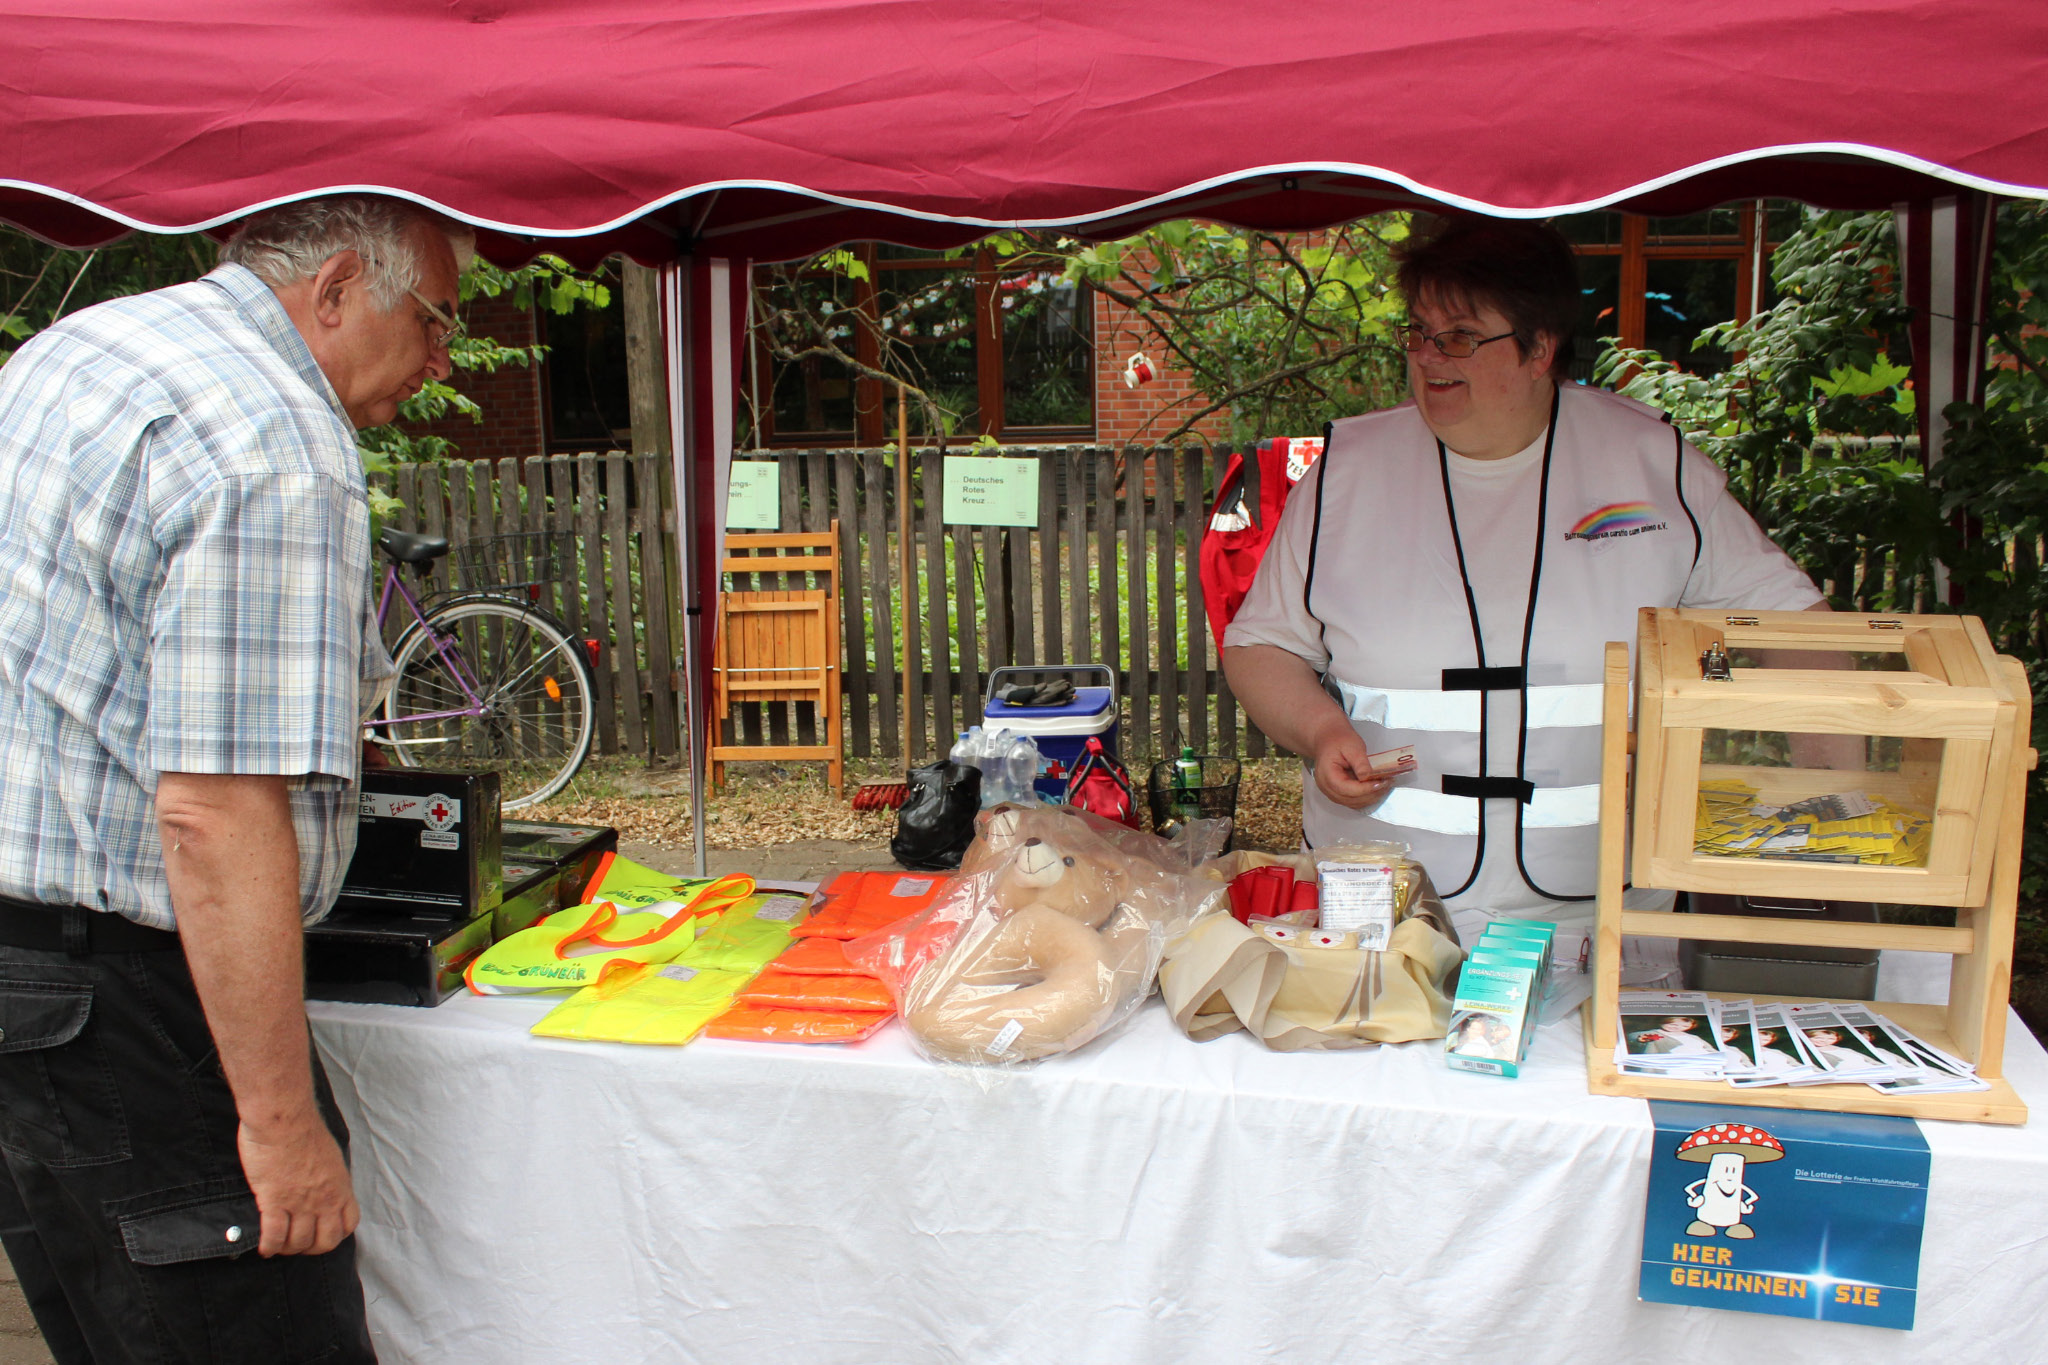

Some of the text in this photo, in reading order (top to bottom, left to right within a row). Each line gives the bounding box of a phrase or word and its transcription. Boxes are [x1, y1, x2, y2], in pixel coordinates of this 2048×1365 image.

[963, 475, 1004, 484] Deutsches
[730, 481, 752, 489] ungs-
[962, 496, 985, 504] Kreuz
[1629, 528, 1640, 536] cum
[1795, 1168, 1809, 1177] Die
[1811, 1170, 1842, 1180] Lotterie
[1672, 1243, 1733, 1266] HIER
[1670, 1267, 1881, 1307] GEWINNEN SIE
